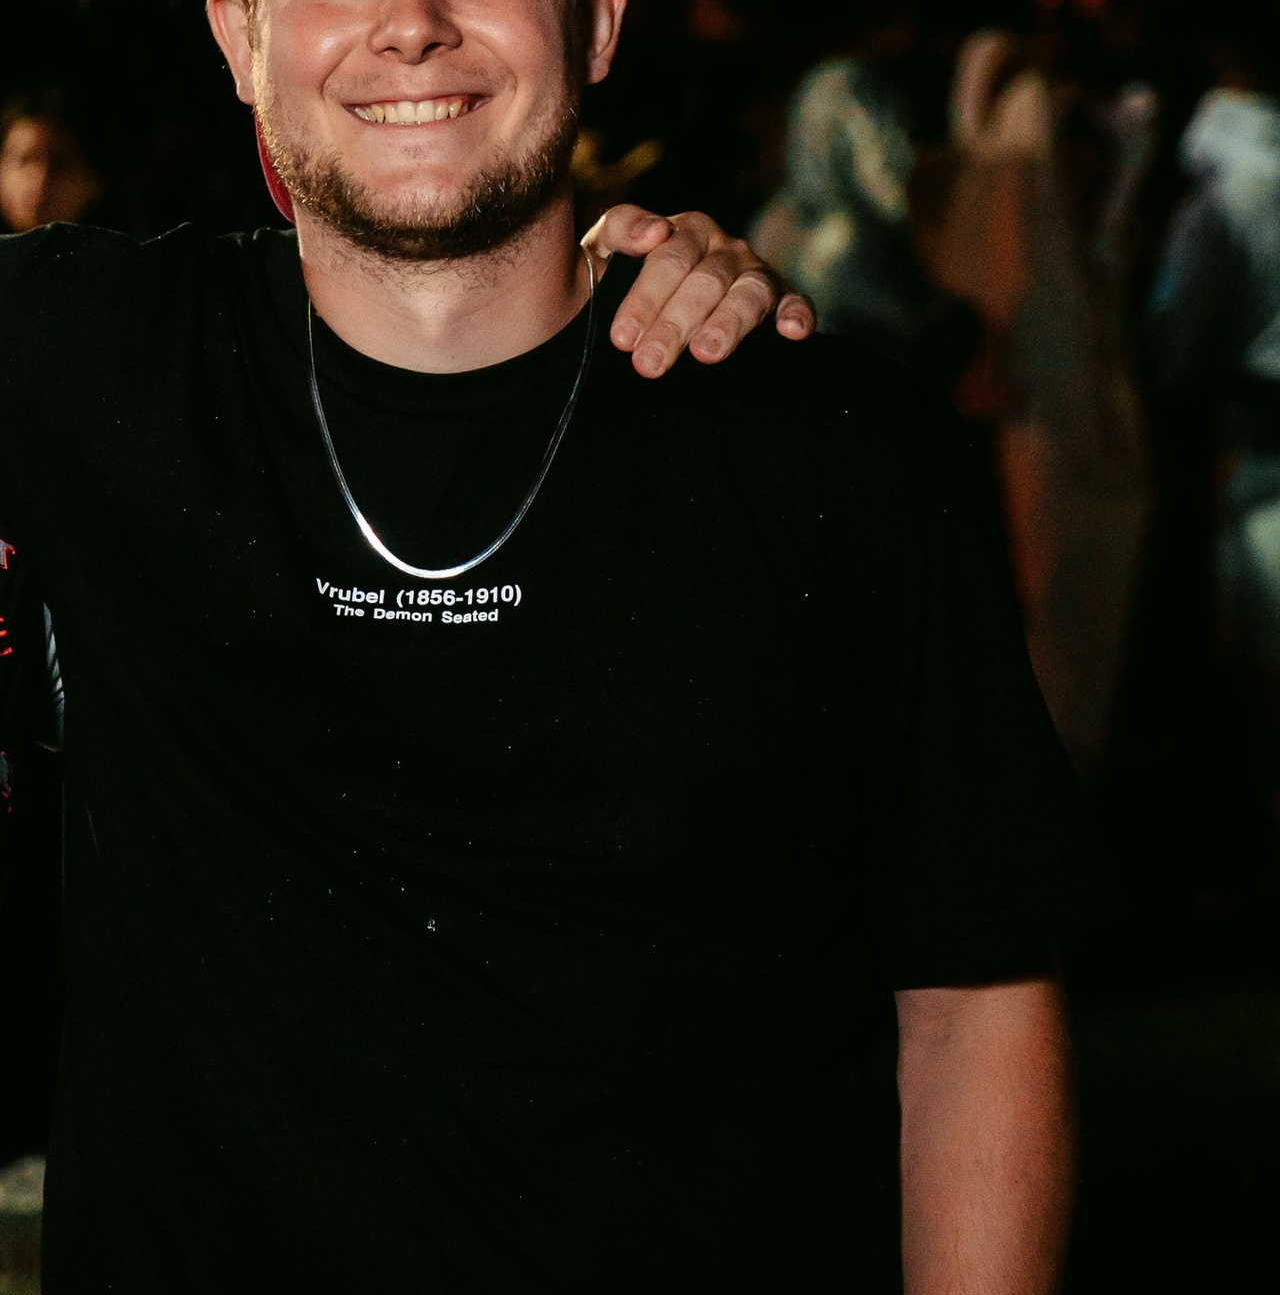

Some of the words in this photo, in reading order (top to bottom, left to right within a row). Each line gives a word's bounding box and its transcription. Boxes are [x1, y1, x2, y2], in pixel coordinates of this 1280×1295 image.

[316, 577, 385, 605] Vrubel
[396, 584, 522, 608] (1856-1910)
[333, 604, 365, 618] The
[373, 608, 433, 623] Demon
[441, 609, 499, 624] Seated
